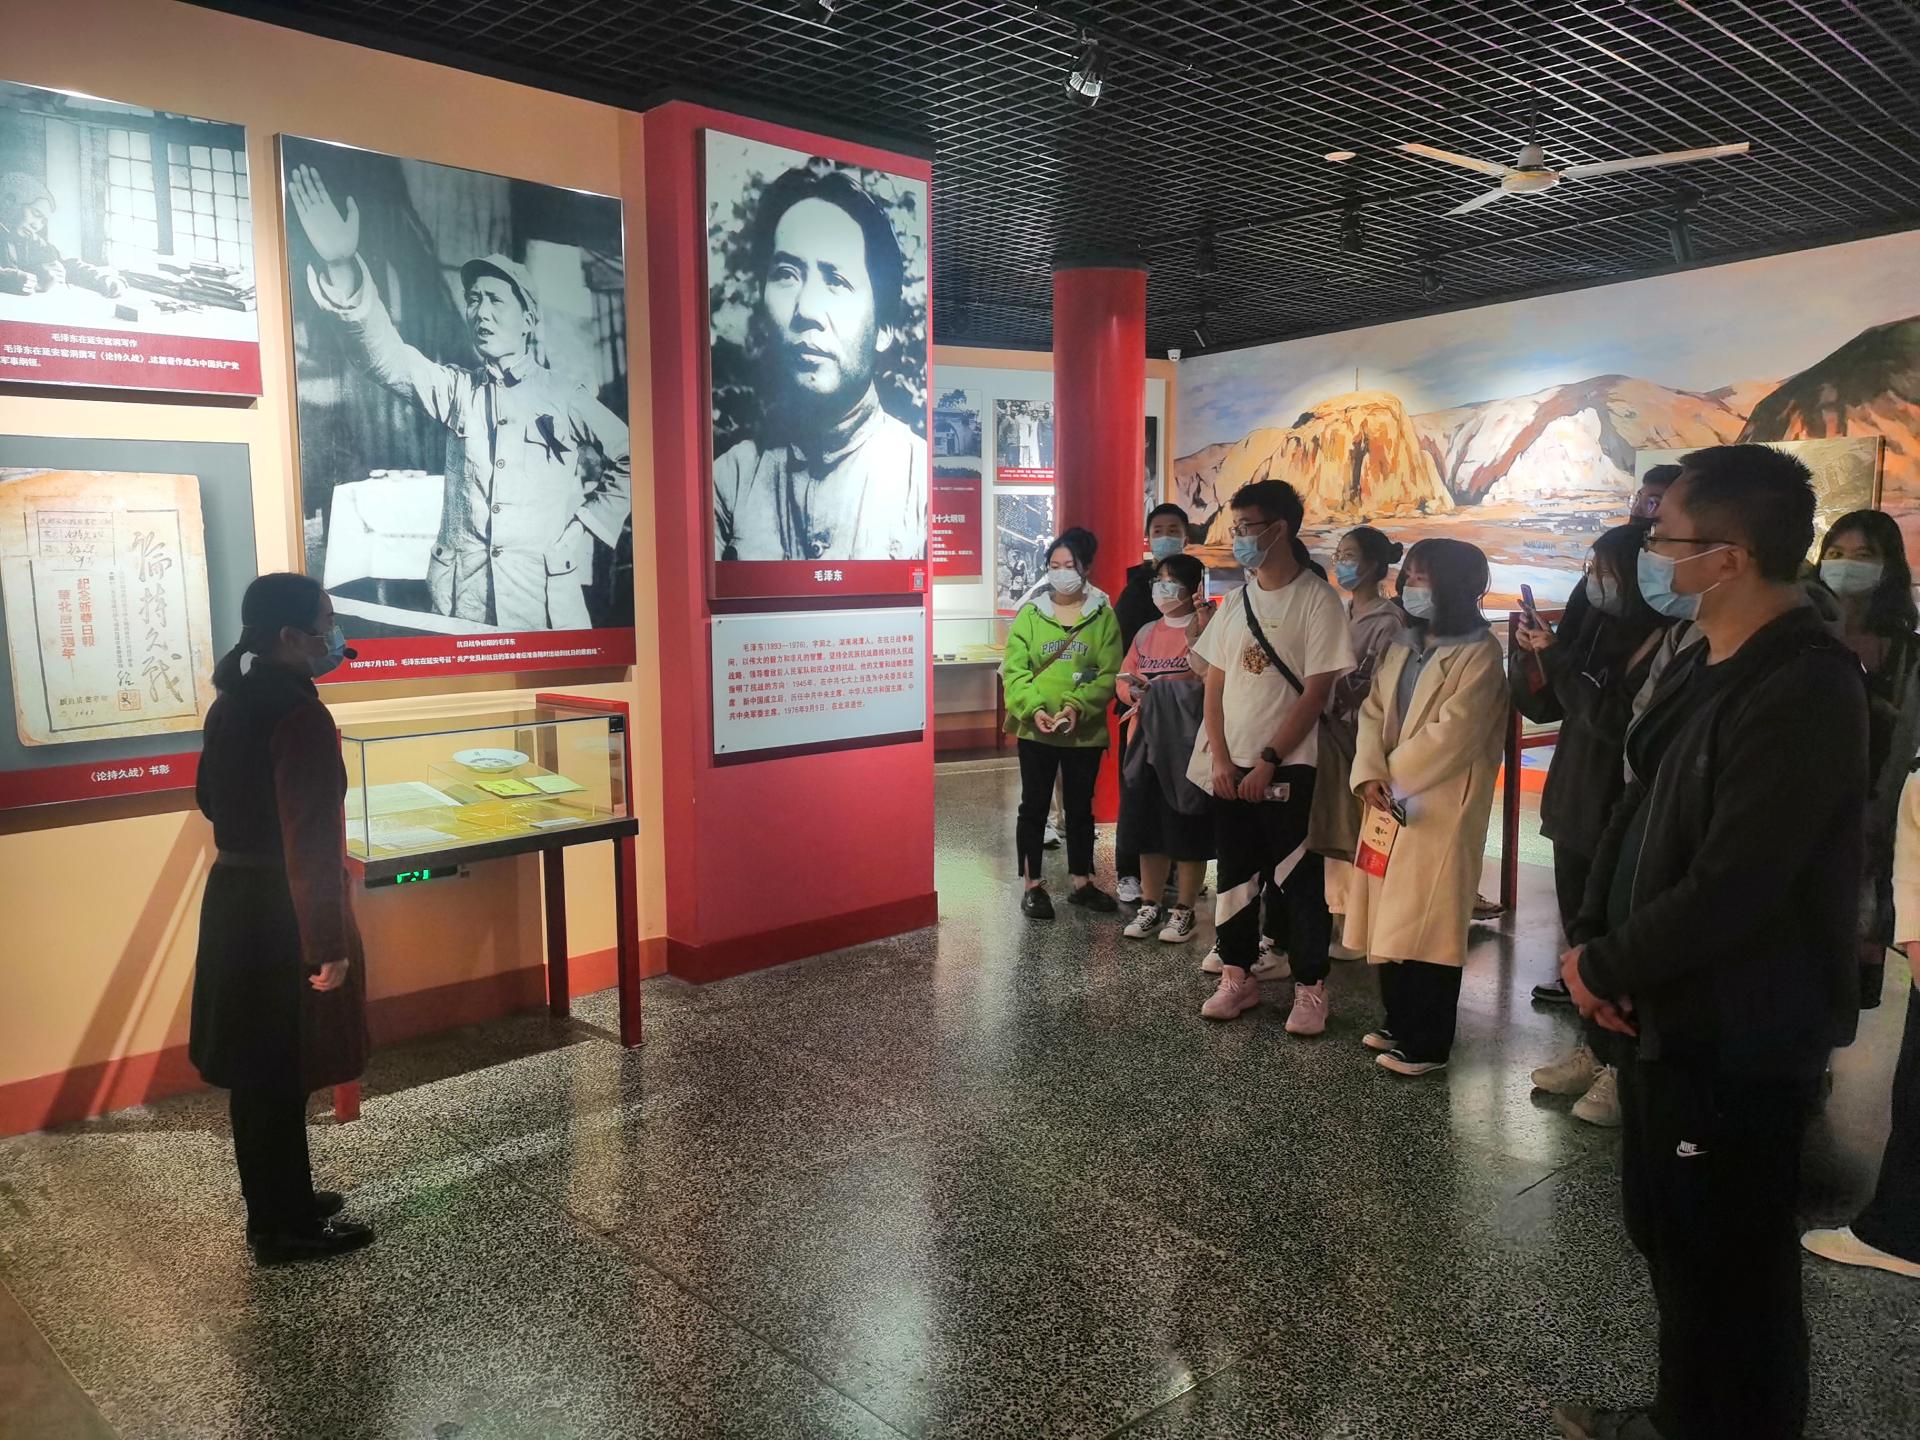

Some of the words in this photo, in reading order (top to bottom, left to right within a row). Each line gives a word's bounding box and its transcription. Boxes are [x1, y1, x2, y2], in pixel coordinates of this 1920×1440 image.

[51, 333, 138, 348] 毛泽东在延安窑洞写作
[814, 570, 843, 582] 毛泽东
[90, 764, 170, 783] 《论持久战》书影
[1680, 1140, 1698, 1153] NIKE
